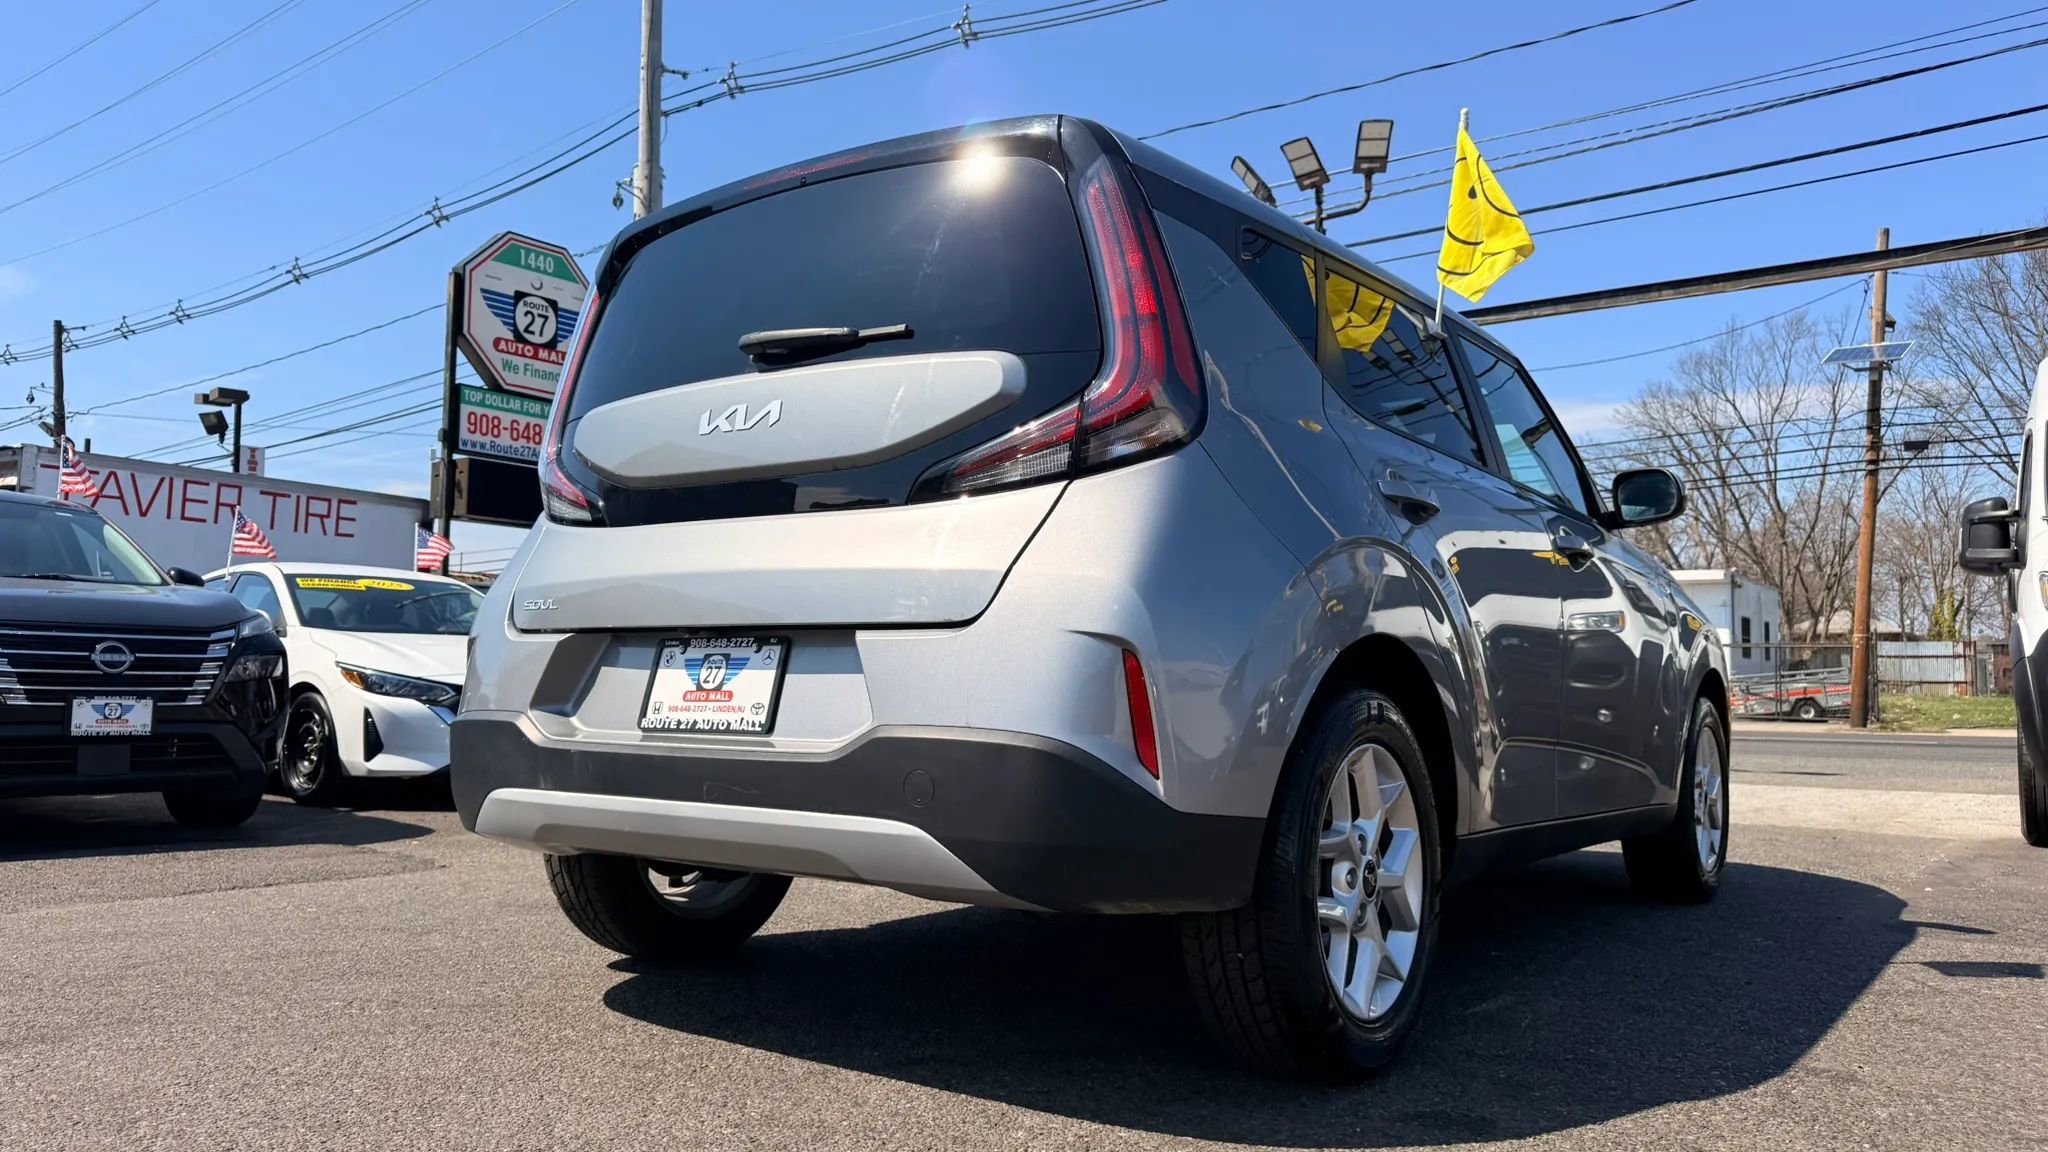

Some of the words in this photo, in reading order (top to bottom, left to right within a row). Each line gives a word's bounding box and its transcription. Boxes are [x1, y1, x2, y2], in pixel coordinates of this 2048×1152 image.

[520, 249, 554, 273] 1440
[523, 300, 550, 314] ROUTE
[523, 310, 550, 337] 27
[498, 339, 533, 356] AUTO
[502, 358, 519, 375] We
[464, 389, 483, 401] TOP
[485, 394, 521, 411] DOLLAR
[523, 401, 541, 414] FOR
[467, 411, 543, 445] 908-648
[259, 489, 358, 538] TIRE
[523, 598, 559, 611] SOUL
[690, 637, 754, 648] 908-648-2727
[702, 666, 722, 684] 27
[685, 692, 706, 700] AUTO
[709, 692, 730, 700] MALL
[107, 708, 119, 717] 27
[640, 717, 678, 729] ROUTE
[679, 718, 696, 730] 27
[696, 718, 728, 730] AUTO
[730, 718, 762, 731] MALL
